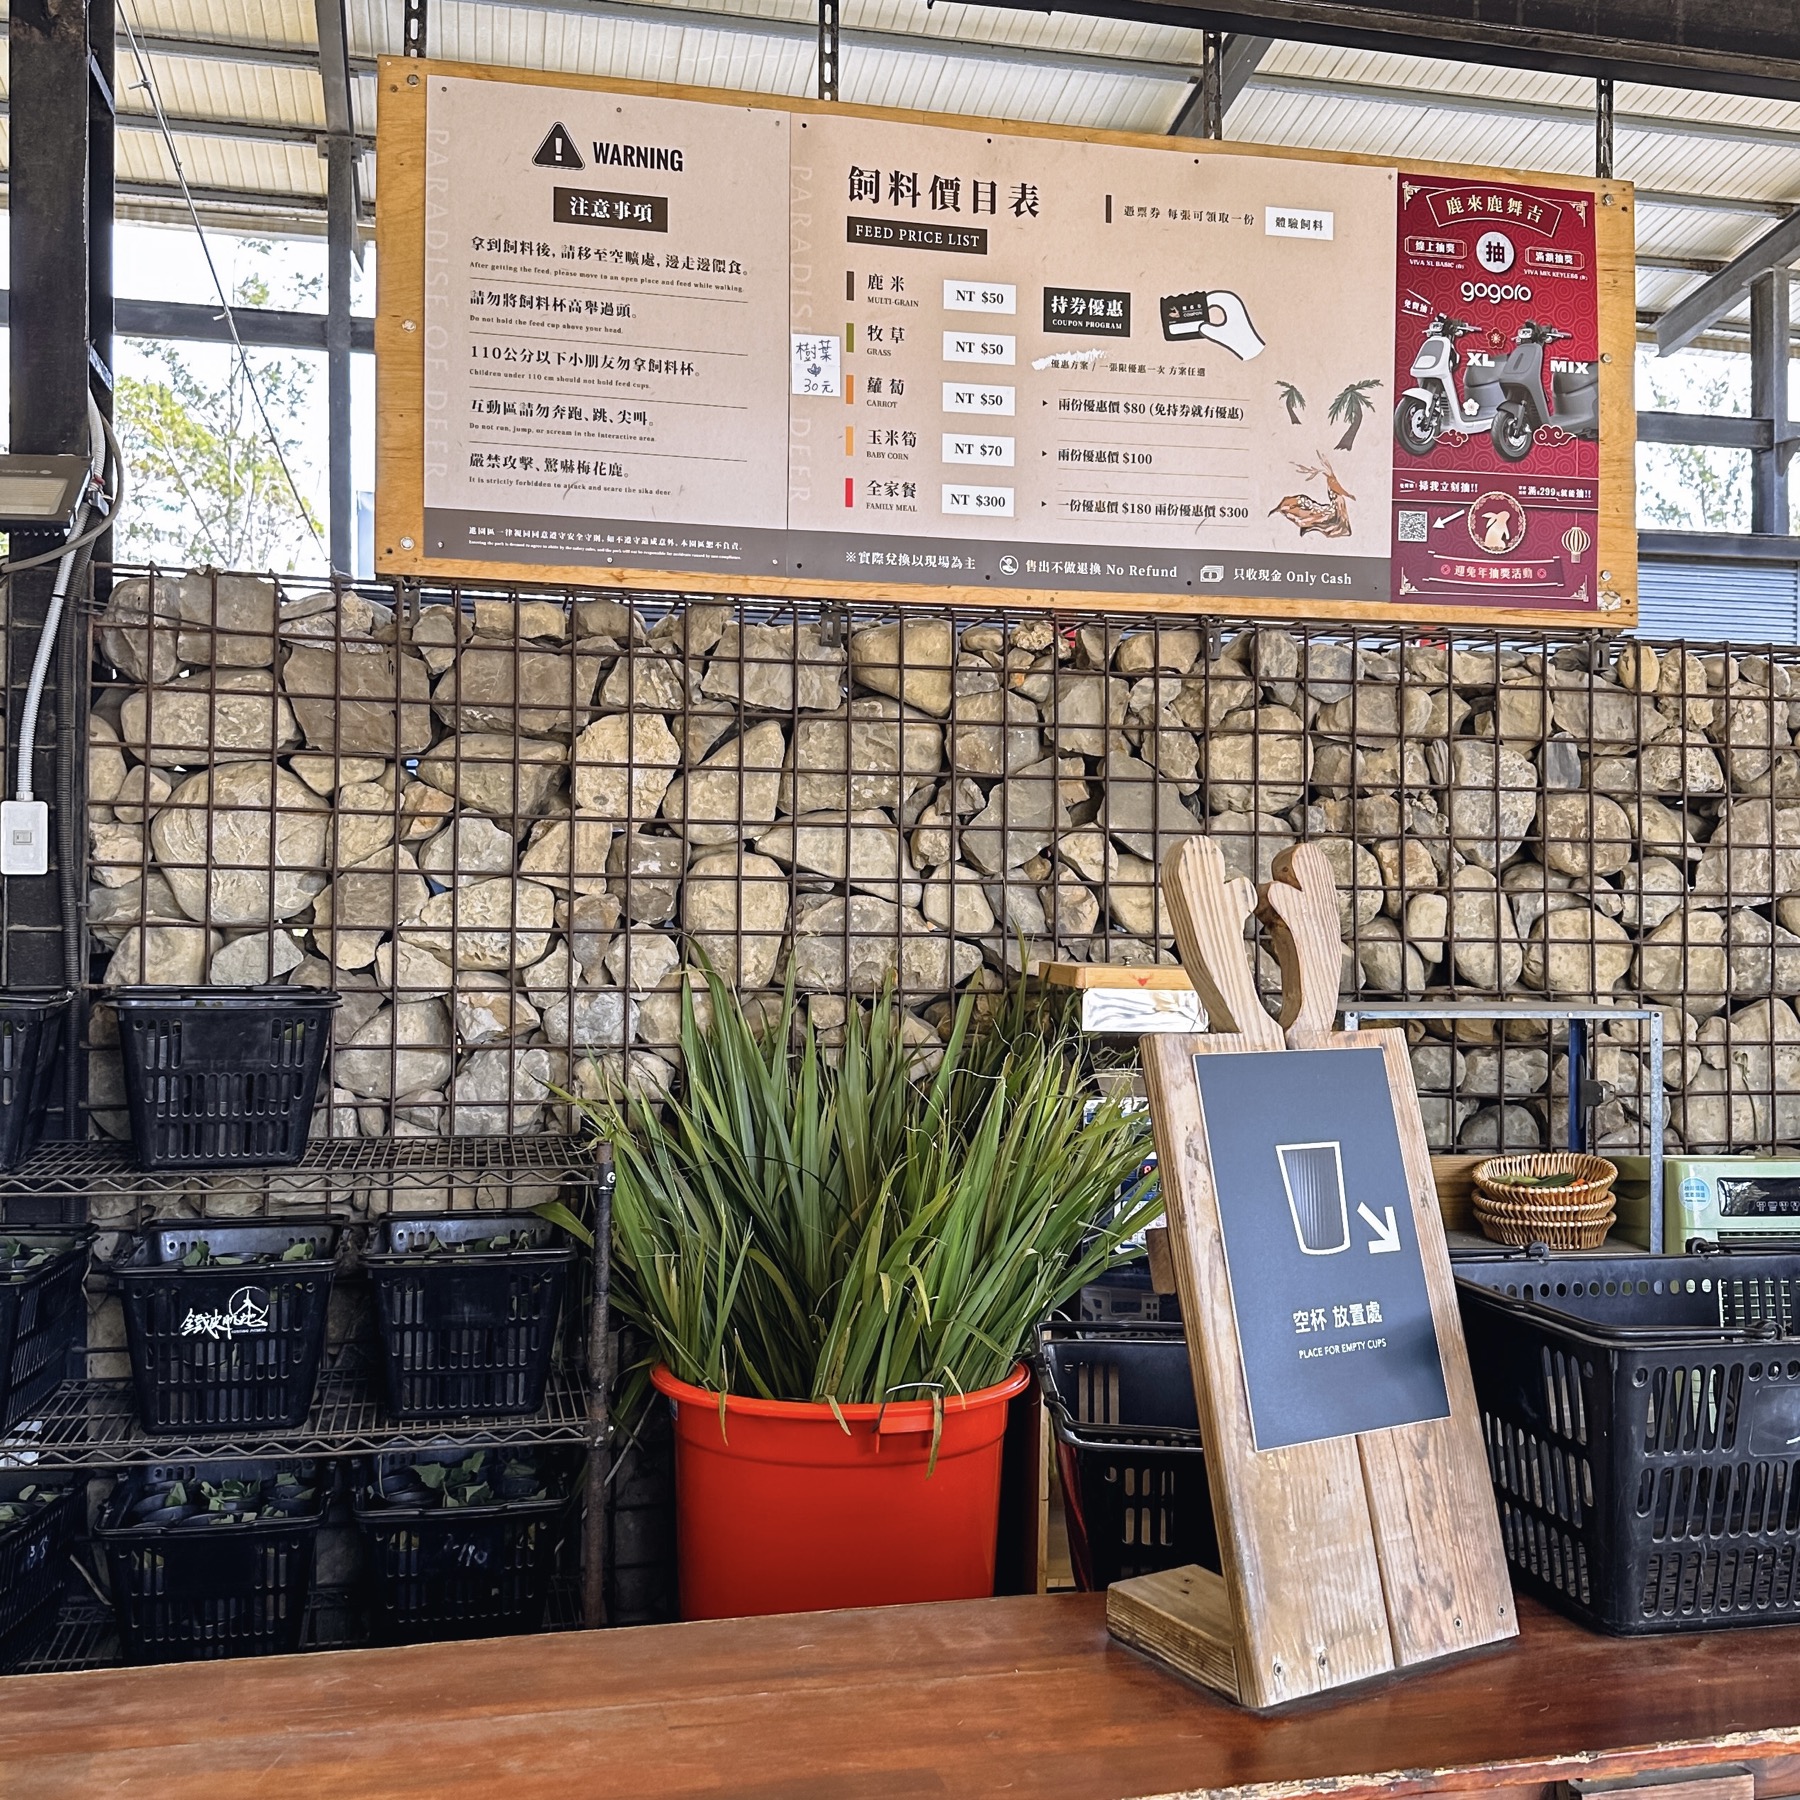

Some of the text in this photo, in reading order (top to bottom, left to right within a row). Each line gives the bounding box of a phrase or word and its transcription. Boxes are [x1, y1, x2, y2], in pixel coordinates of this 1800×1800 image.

[592, 141, 683, 172] WARNING
[848, 165, 1040, 218] 飼料價目表
[570, 196, 652, 223] 注意事項
[1167, 208, 1255, 226] 每張可領取一份
[1446, 194, 1544, 224] 鹿來鹿舞吉
[1275, 216, 1323, 231] 體驗飼料
[855, 224, 980, 247] FEED PRICE LIST
[1486, 240, 1506, 264] 抽
[1409, 258, 1425, 266] VIVA
[491, 265, 518, 273] getting
[554, 269, 577, 277] please
[621, 275, 638, 283] open
[640, 276, 659, 285] place
[676, 280, 691, 288] feed
[694, 281, 712, 289] while
[1523, 268, 1539, 276] VIVA
[867, 273, 905, 292] 鹿米
[867, 296, 919, 307] MULTI-GRAIN
[955, 289, 1004, 304] NT $50
[1460, 281, 1532, 304] gogoro
[1050, 295, 1124, 317] 持券優惠
[470, 314, 480, 322] Do
[496, 316, 513, 325] hold
[515, 318, 527, 326] the
[529, 319, 545, 327] feed
[547, 322, 560, 330] cup
[562, 322, 583, 331] above
[1052, 318, 1122, 330] COUPON PROGRAM
[867, 324, 905, 344] 牧草
[796, 339, 832, 362] 樹葉
[867, 348, 892, 357] GRASS
[955, 341, 1004, 356] NT $50
[1099, 362, 1166, 375] 一張限優惠一次
[1466, 352, 1496, 368] XL
[1550, 360, 1590, 375] MIX
[469, 368, 501, 377] Children
[503, 371, 525, 379] under
[556, 375, 581, 384] should
[583, 377, 595, 385] not
[597, 378, 613, 386] hold
[615, 379, 631, 388] feed
[867, 376, 905, 396] 蘿蔔
[866, 399, 898, 409] CARROT
[955, 392, 1003, 407] NT $50
[1058, 397, 1120, 414] 兩份優惠價
[1123, 402, 1146, 415] $80
[482, 423, 494, 431] not
[574, 429, 581, 437] in
[597, 432, 637, 441] interactive
[867, 429, 917, 448] 玉米筍
[866, 450, 909, 461] BABY CORN
[954, 443, 1003, 457] NT $70
[1058, 447, 1153, 465] 兩份優惠價 $100
[486, 477, 513, 487] strictly
[515, 479, 552, 488] forbidden
[624, 486, 636, 494] the
[638, 487, 653, 495] sika
[867, 479, 917, 499] 全家餐
[866, 502, 918, 512] FAMILY MEAL
[950, 493, 1006, 508] NT $300
[1057, 499, 1249, 519] 一份優惠價 $180 兩份優惠價 $300
[1025, 559, 1178, 578] 售出不做退換 No Refund
[1233, 567, 1352, 586] 只收現金 Only Cash
[1454, 565, 1533, 579] 迎兔年抽獎活動
[1292, 1300, 1383, 1334] 空杯 放置處
[1298, 1338, 1387, 1359] PLACE FOR EMPTY CUPS
